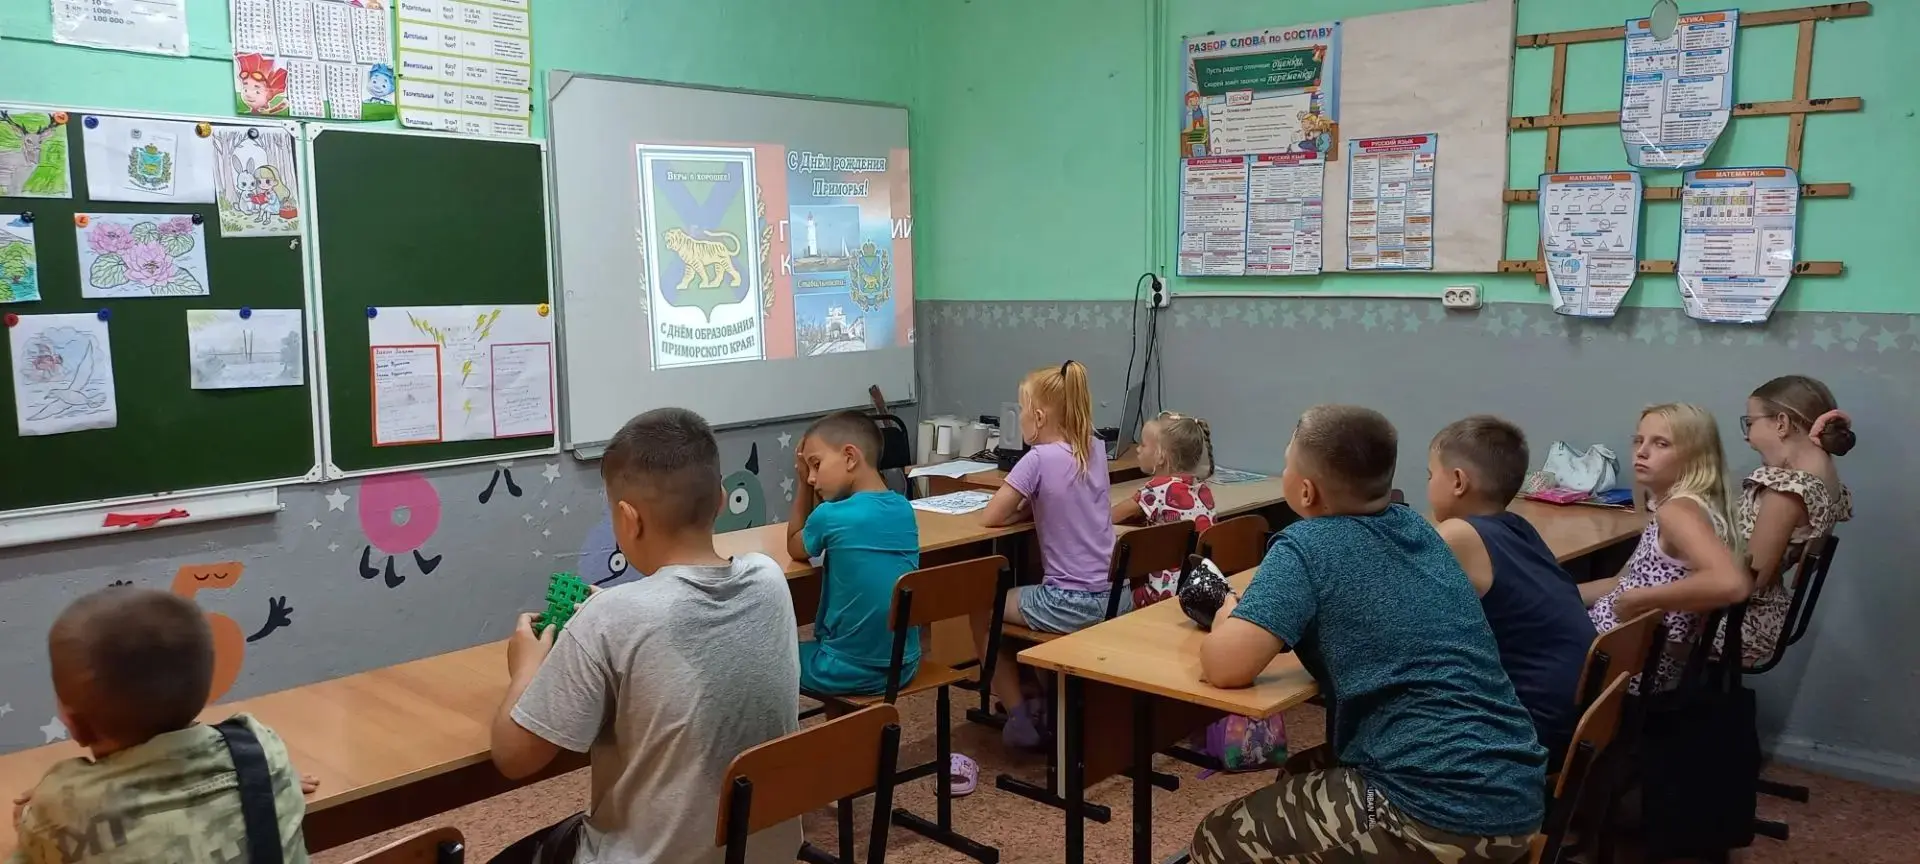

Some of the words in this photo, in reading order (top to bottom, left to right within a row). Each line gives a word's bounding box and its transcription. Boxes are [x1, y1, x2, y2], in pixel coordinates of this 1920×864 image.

[1188, 40, 1227, 53] РАЗБОР
[1230, 35, 1266, 49] СЛОВА
[1283, 27, 1333, 41] СОСТАВУ
[1715, 170, 1765, 178] МАТЕМАТИКА
[667, 322, 693, 340] ДНЁМ
[694, 316, 755, 340] ОБРАЗОВАНИЯ
[661, 340, 729, 358] ПРИМОРСКОГО
[729, 335, 755, 354] КРАЯ!
[1366, 788, 1375, 812] URBAN
